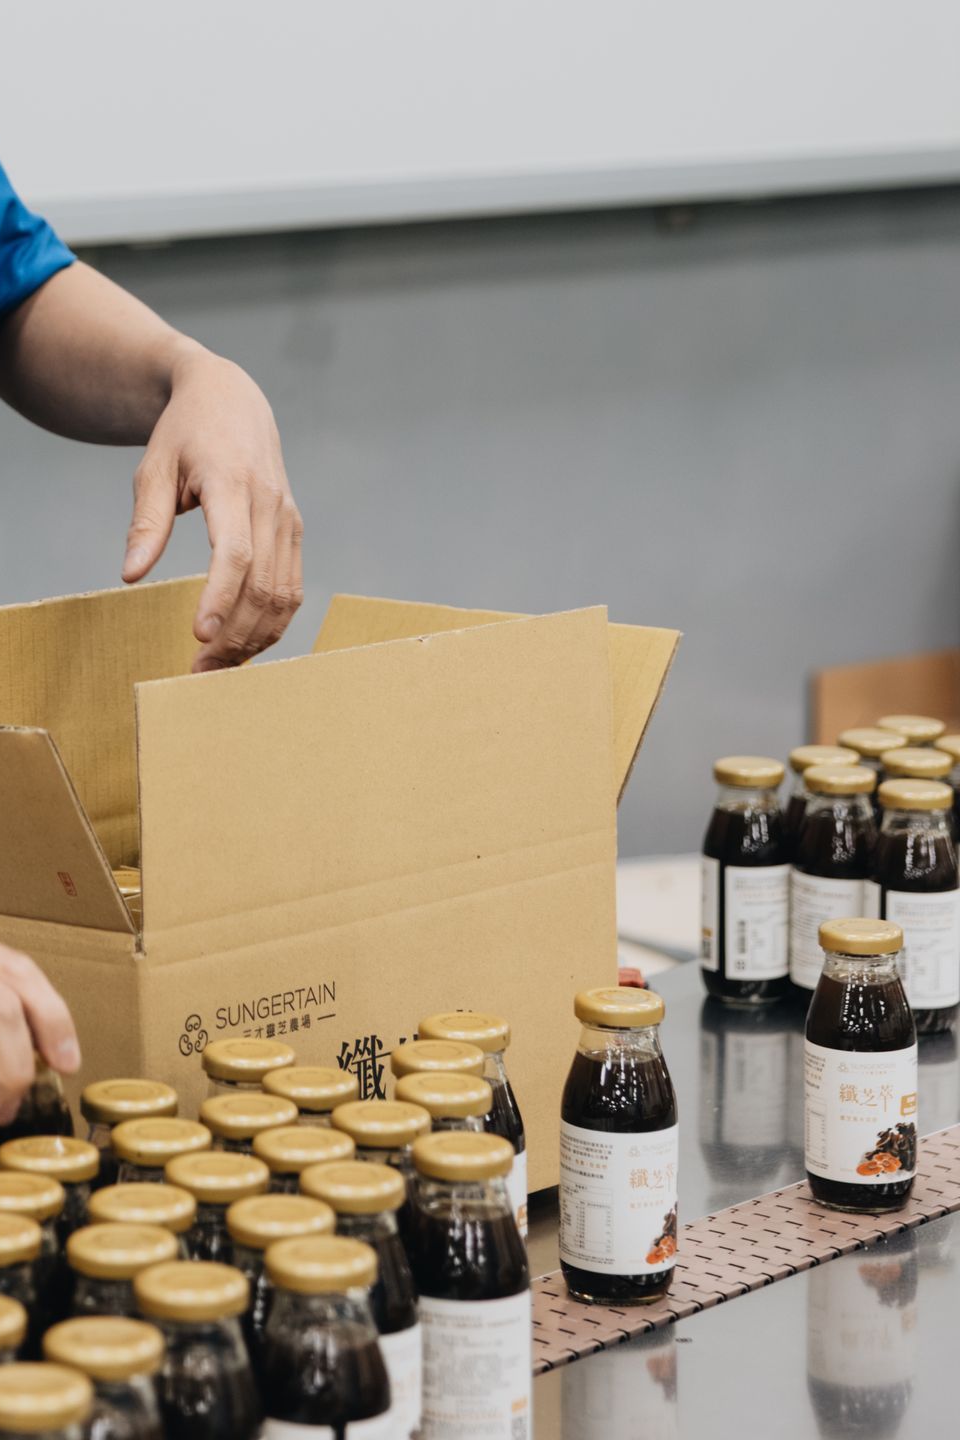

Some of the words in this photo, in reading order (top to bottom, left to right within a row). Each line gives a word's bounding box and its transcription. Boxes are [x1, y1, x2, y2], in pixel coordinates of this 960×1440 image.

[215, 981, 336, 1030] SUNGERTAIN
[243, 1014, 311, 1039] 三才靈芝農場
